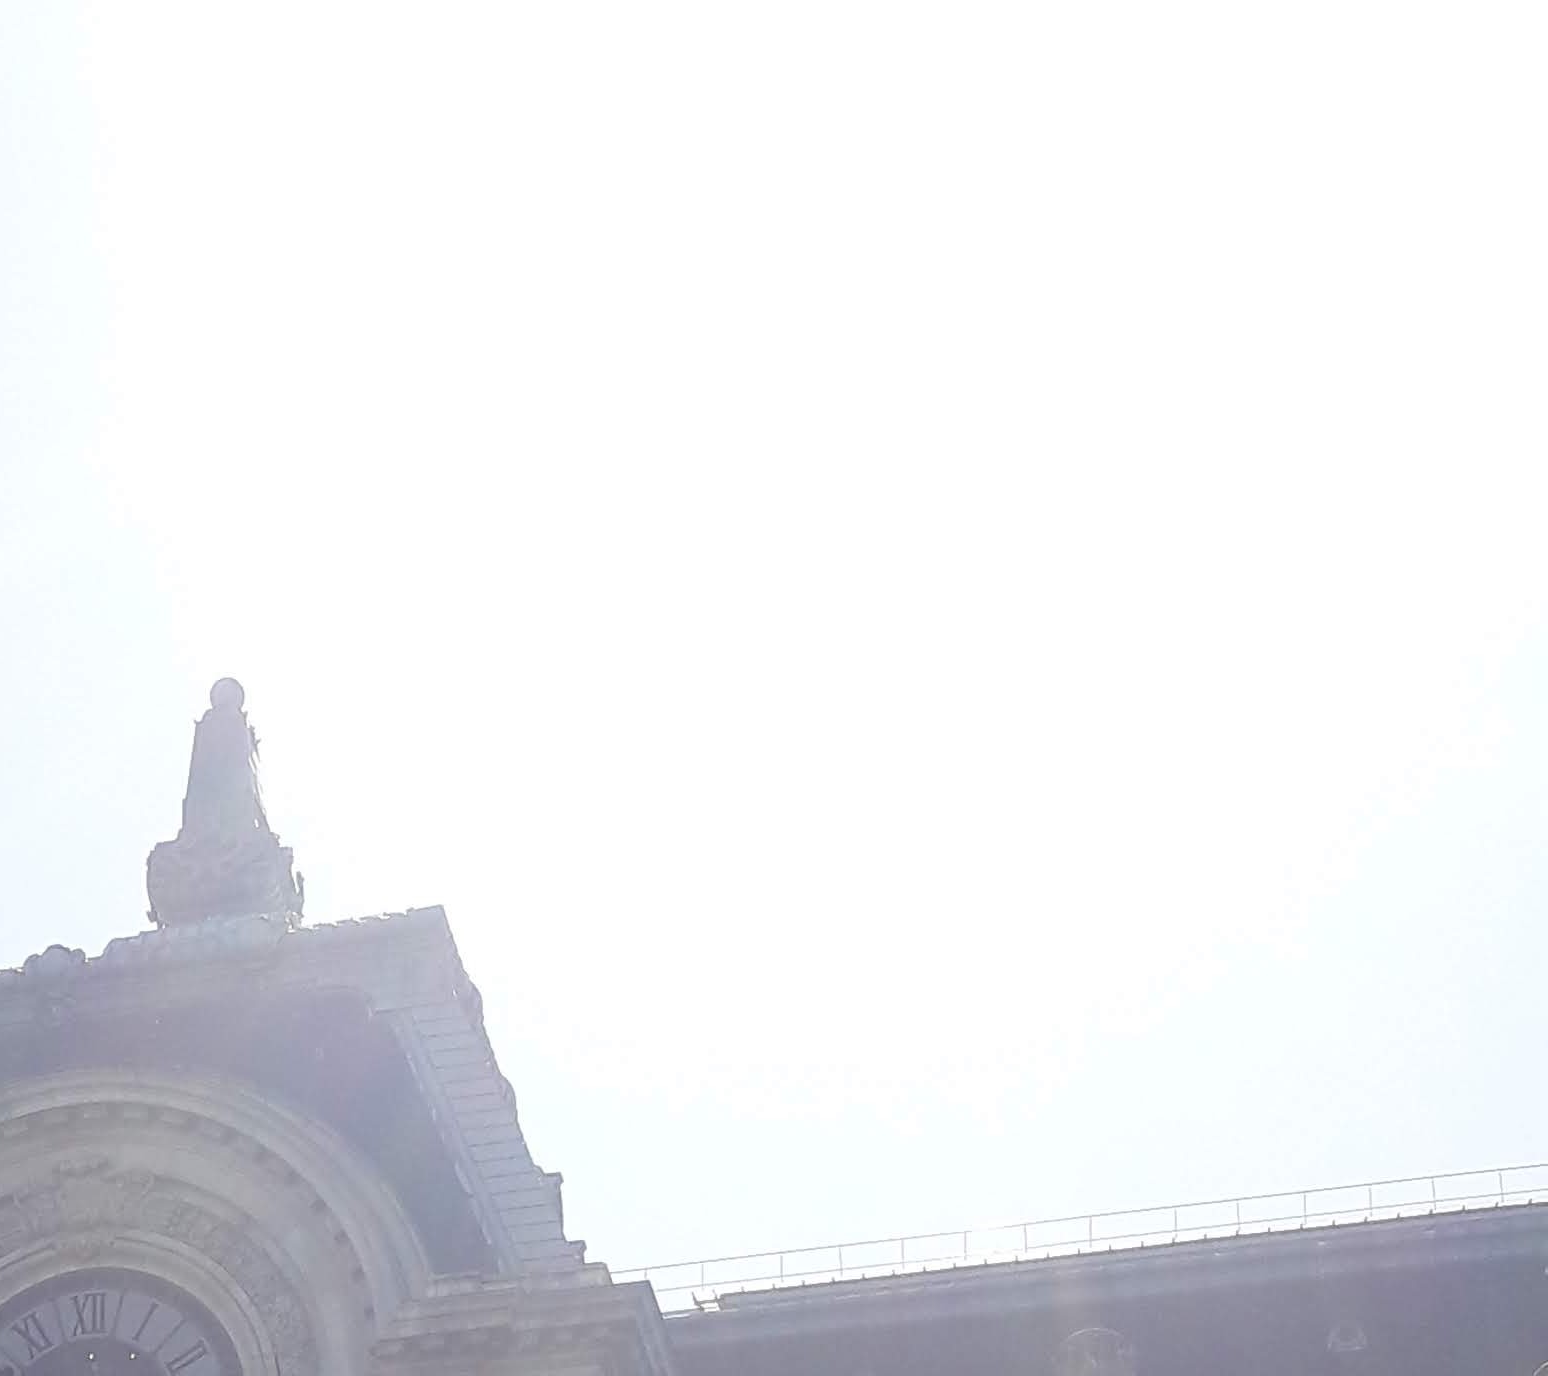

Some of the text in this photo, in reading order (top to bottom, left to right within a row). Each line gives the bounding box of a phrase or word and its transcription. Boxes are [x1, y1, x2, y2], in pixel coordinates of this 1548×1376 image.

[71, 1292, 107, 1336] XII
[132, 1300, 161, 1341] I
[12, 1311, 55, 1360] XI
[165, 1338, 207, 1376] II
